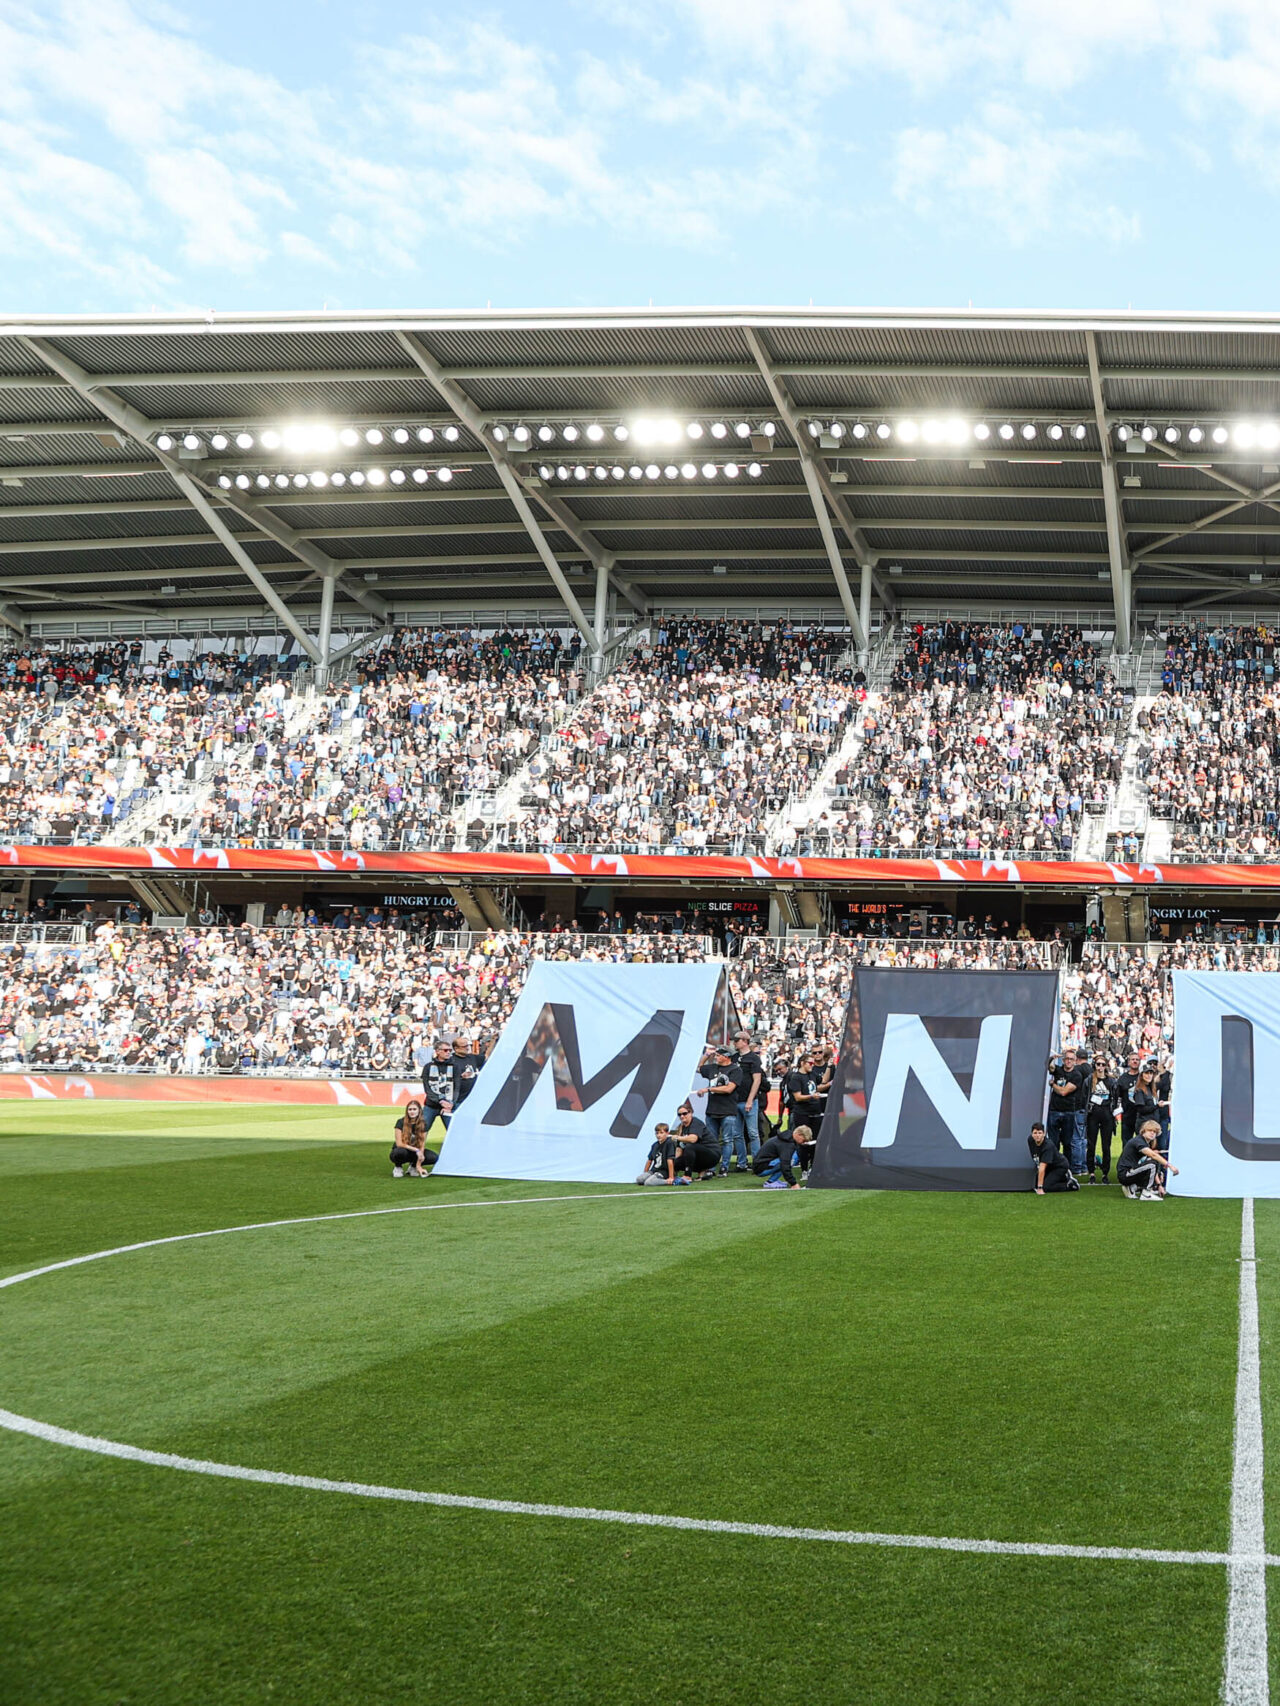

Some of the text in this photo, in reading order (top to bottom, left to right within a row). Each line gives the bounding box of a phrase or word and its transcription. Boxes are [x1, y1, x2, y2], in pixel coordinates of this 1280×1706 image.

[384, 896, 431, 906] HUNGRY
[688, 902, 758, 911] NICE SLICE PIZZA
[848, 904, 859, 913] THE
[480, 1002, 684, 1139] M
[860, 1013, 1013, 1150] N
